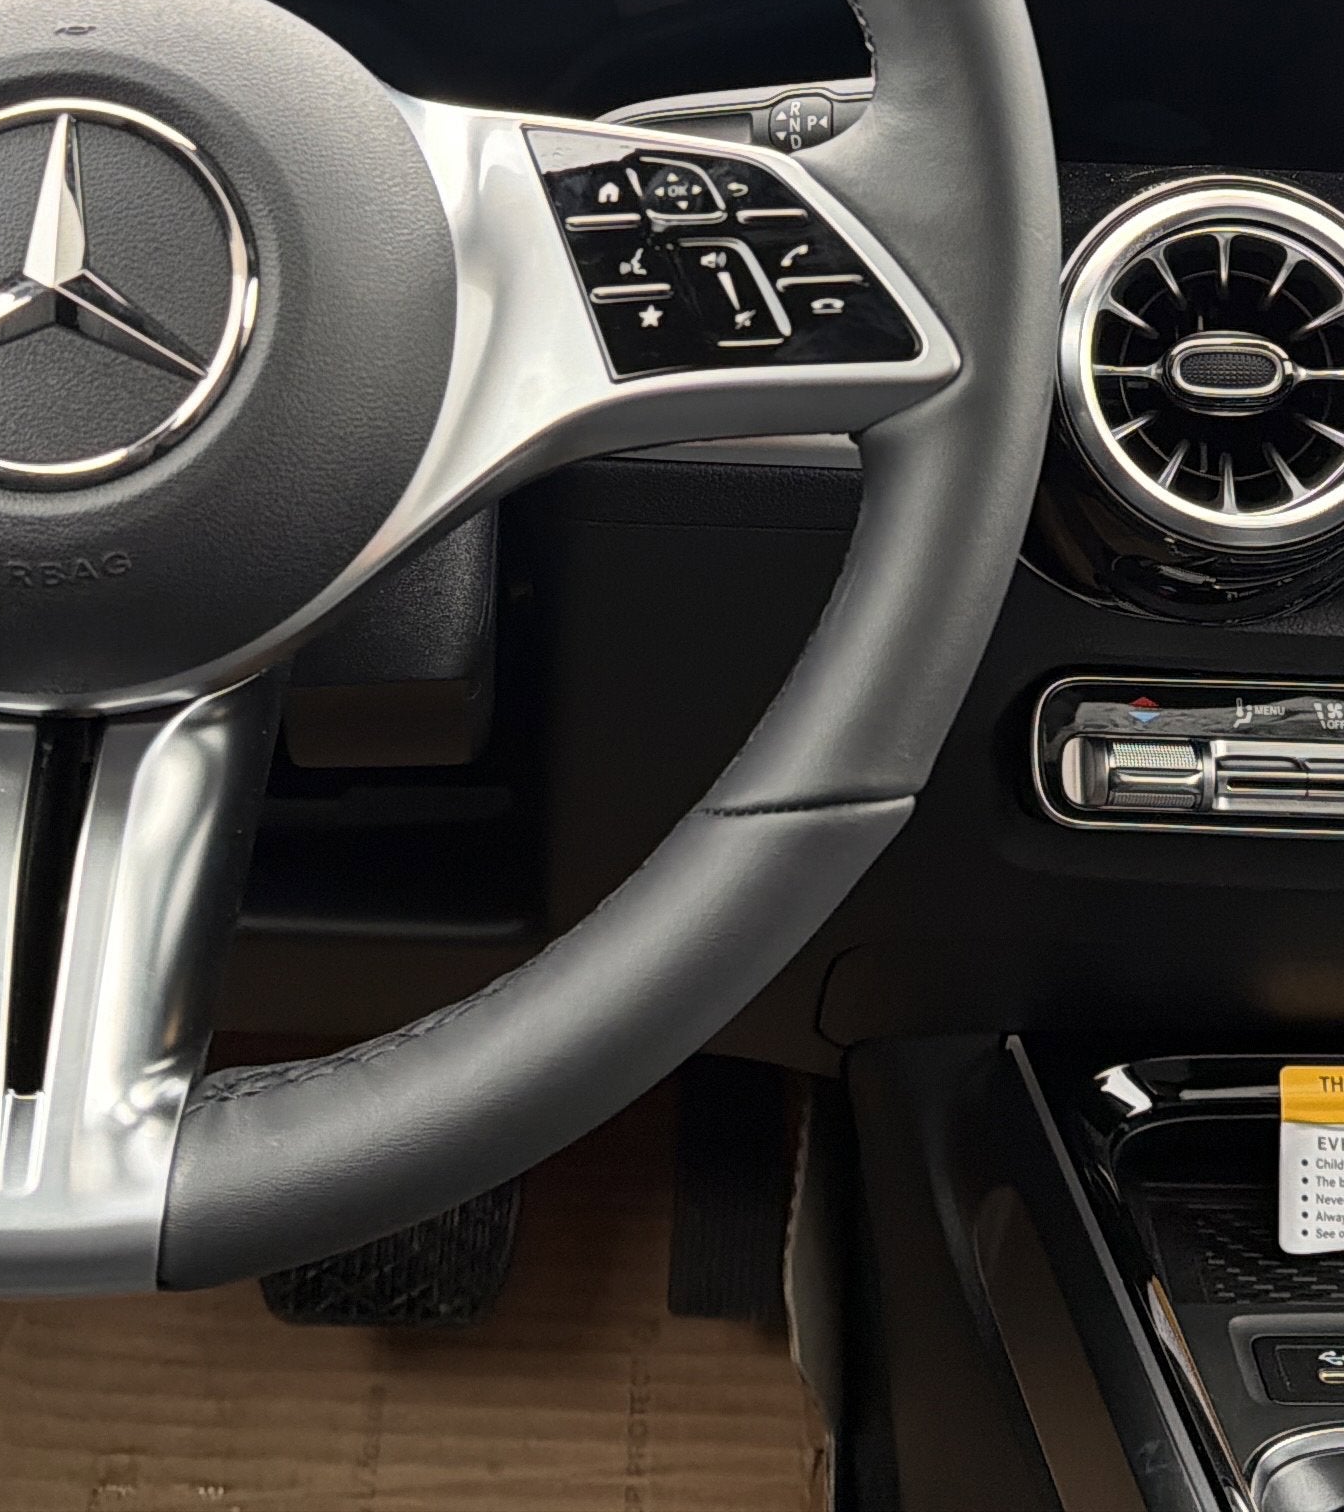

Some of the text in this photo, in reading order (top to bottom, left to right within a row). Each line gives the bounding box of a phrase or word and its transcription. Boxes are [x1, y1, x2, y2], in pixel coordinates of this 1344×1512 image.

[790, 101, 801, 116] R
[789, 116, 818, 131] N P
[791, 134, 802, 149] D
[667, 184, 689, 198] OK
[1254, 705, 1286, 716] MENU
[1316, 1175, 1336, 1188] The
[1316, 1228, 1336, 1239] See
